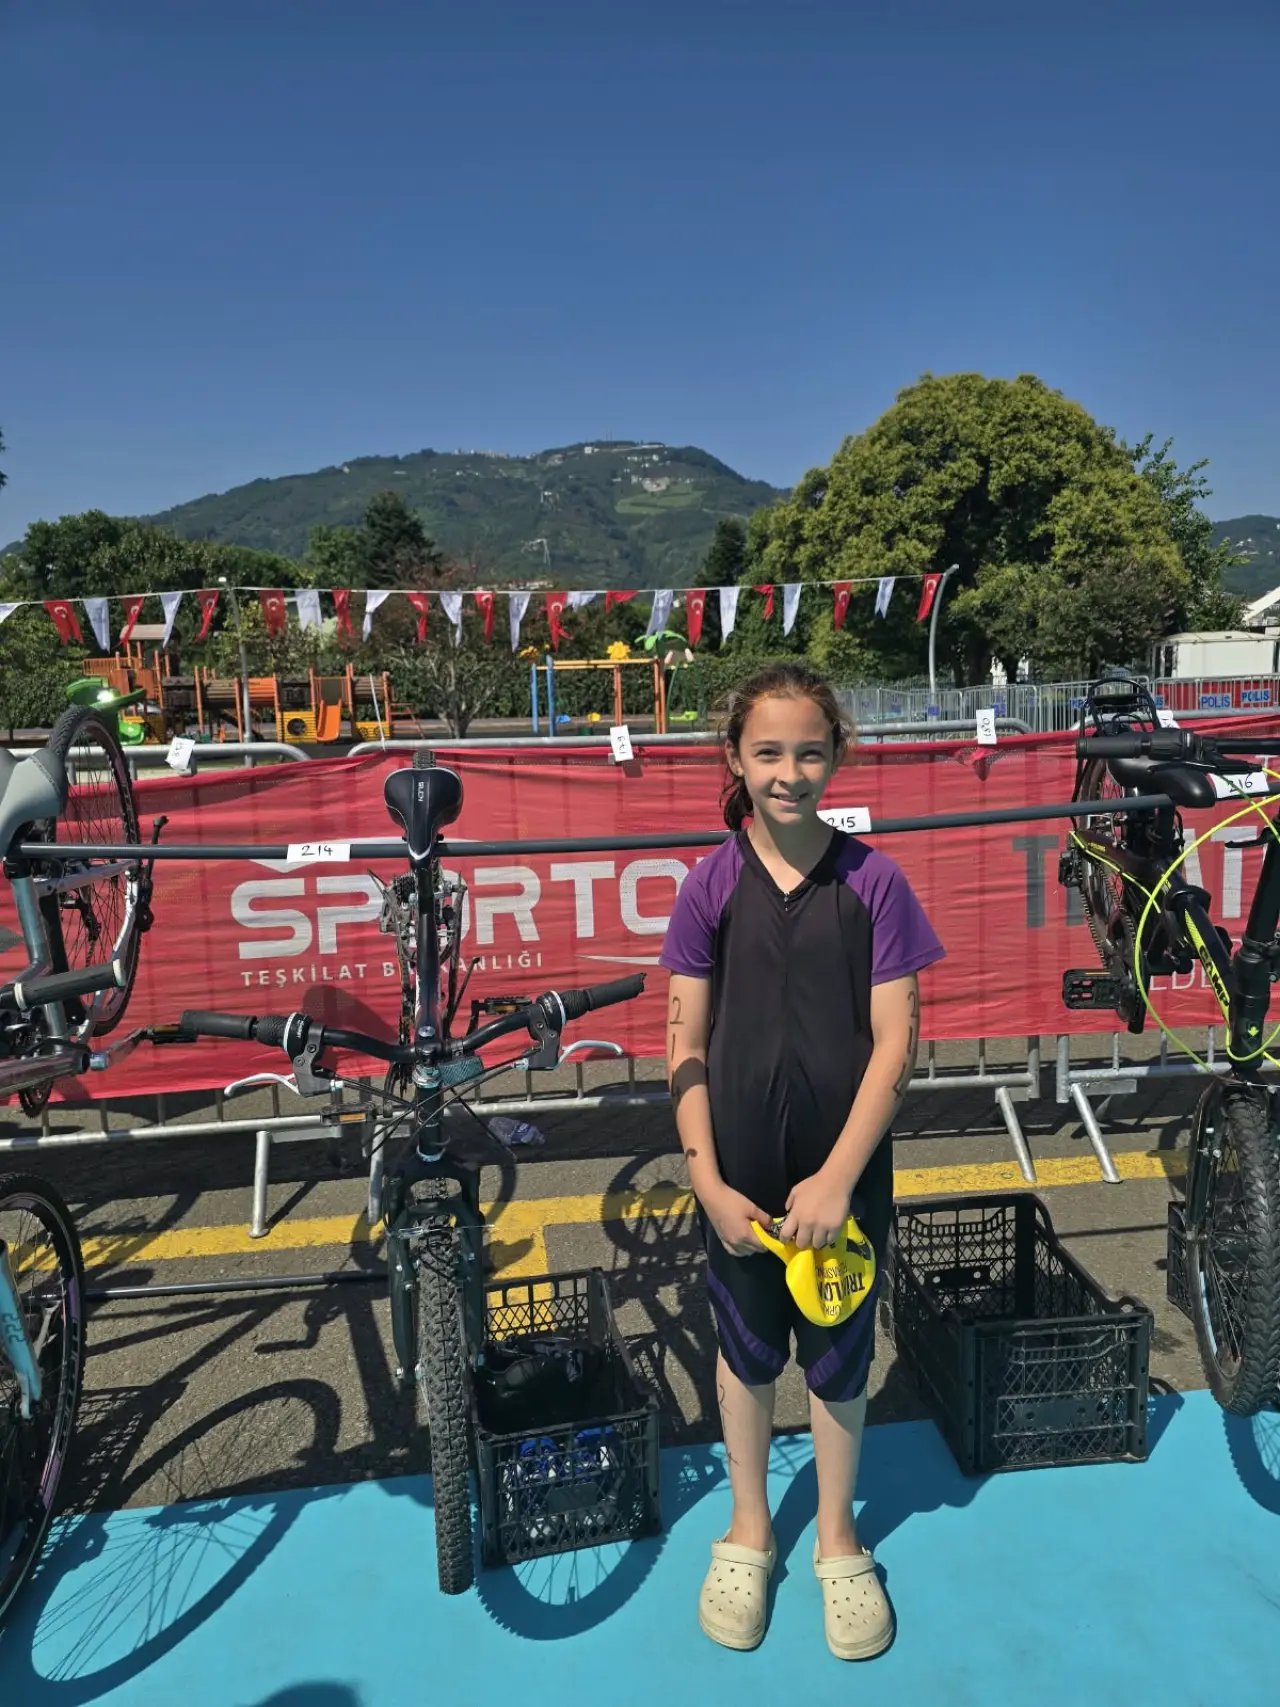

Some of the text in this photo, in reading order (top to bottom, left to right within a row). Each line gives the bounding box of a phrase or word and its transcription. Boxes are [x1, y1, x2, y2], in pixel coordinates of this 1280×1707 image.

[1228, 773, 1253, 793] 216
[301, 844, 334, 857] 214
[241, 950, 543, 989] TEŞKİLAT BANLIĞI
